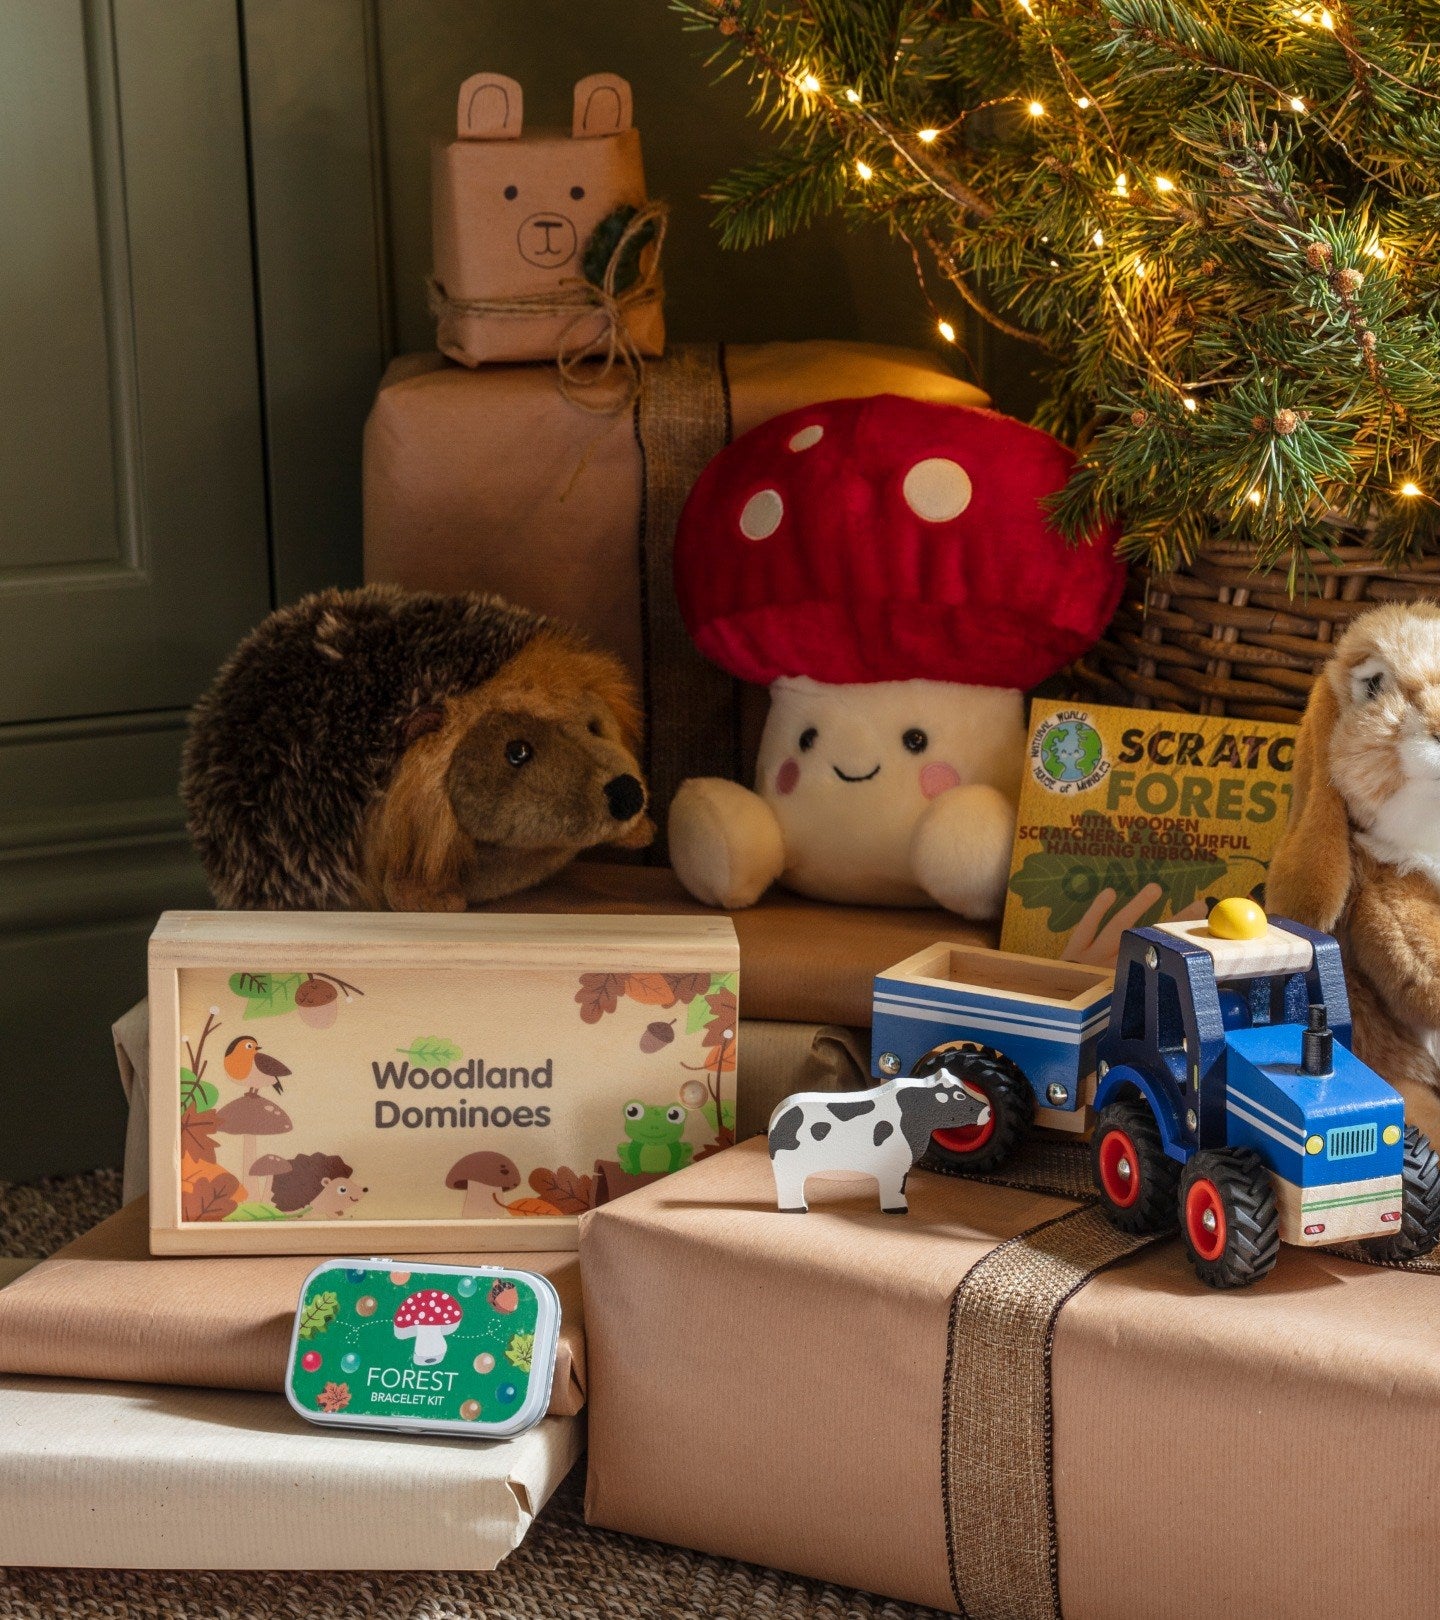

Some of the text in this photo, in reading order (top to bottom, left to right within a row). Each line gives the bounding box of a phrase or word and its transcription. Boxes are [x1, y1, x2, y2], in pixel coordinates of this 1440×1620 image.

[1056, 711, 1088, 722] WORLD
[1070, 814, 1199, 833] WITH WOODEN
[1018, 826, 1250, 850] SCRATCHERS & COLOURFUL
[1047, 841, 1218, 865] HANGING RIBBONS
[371, 1058, 553, 1090] Woodland
[374, 1100, 551, 1129] Dominoes
[366, 1367, 459, 1391] FOREST
[370, 1392, 444, 1406] BRACELET KIT
